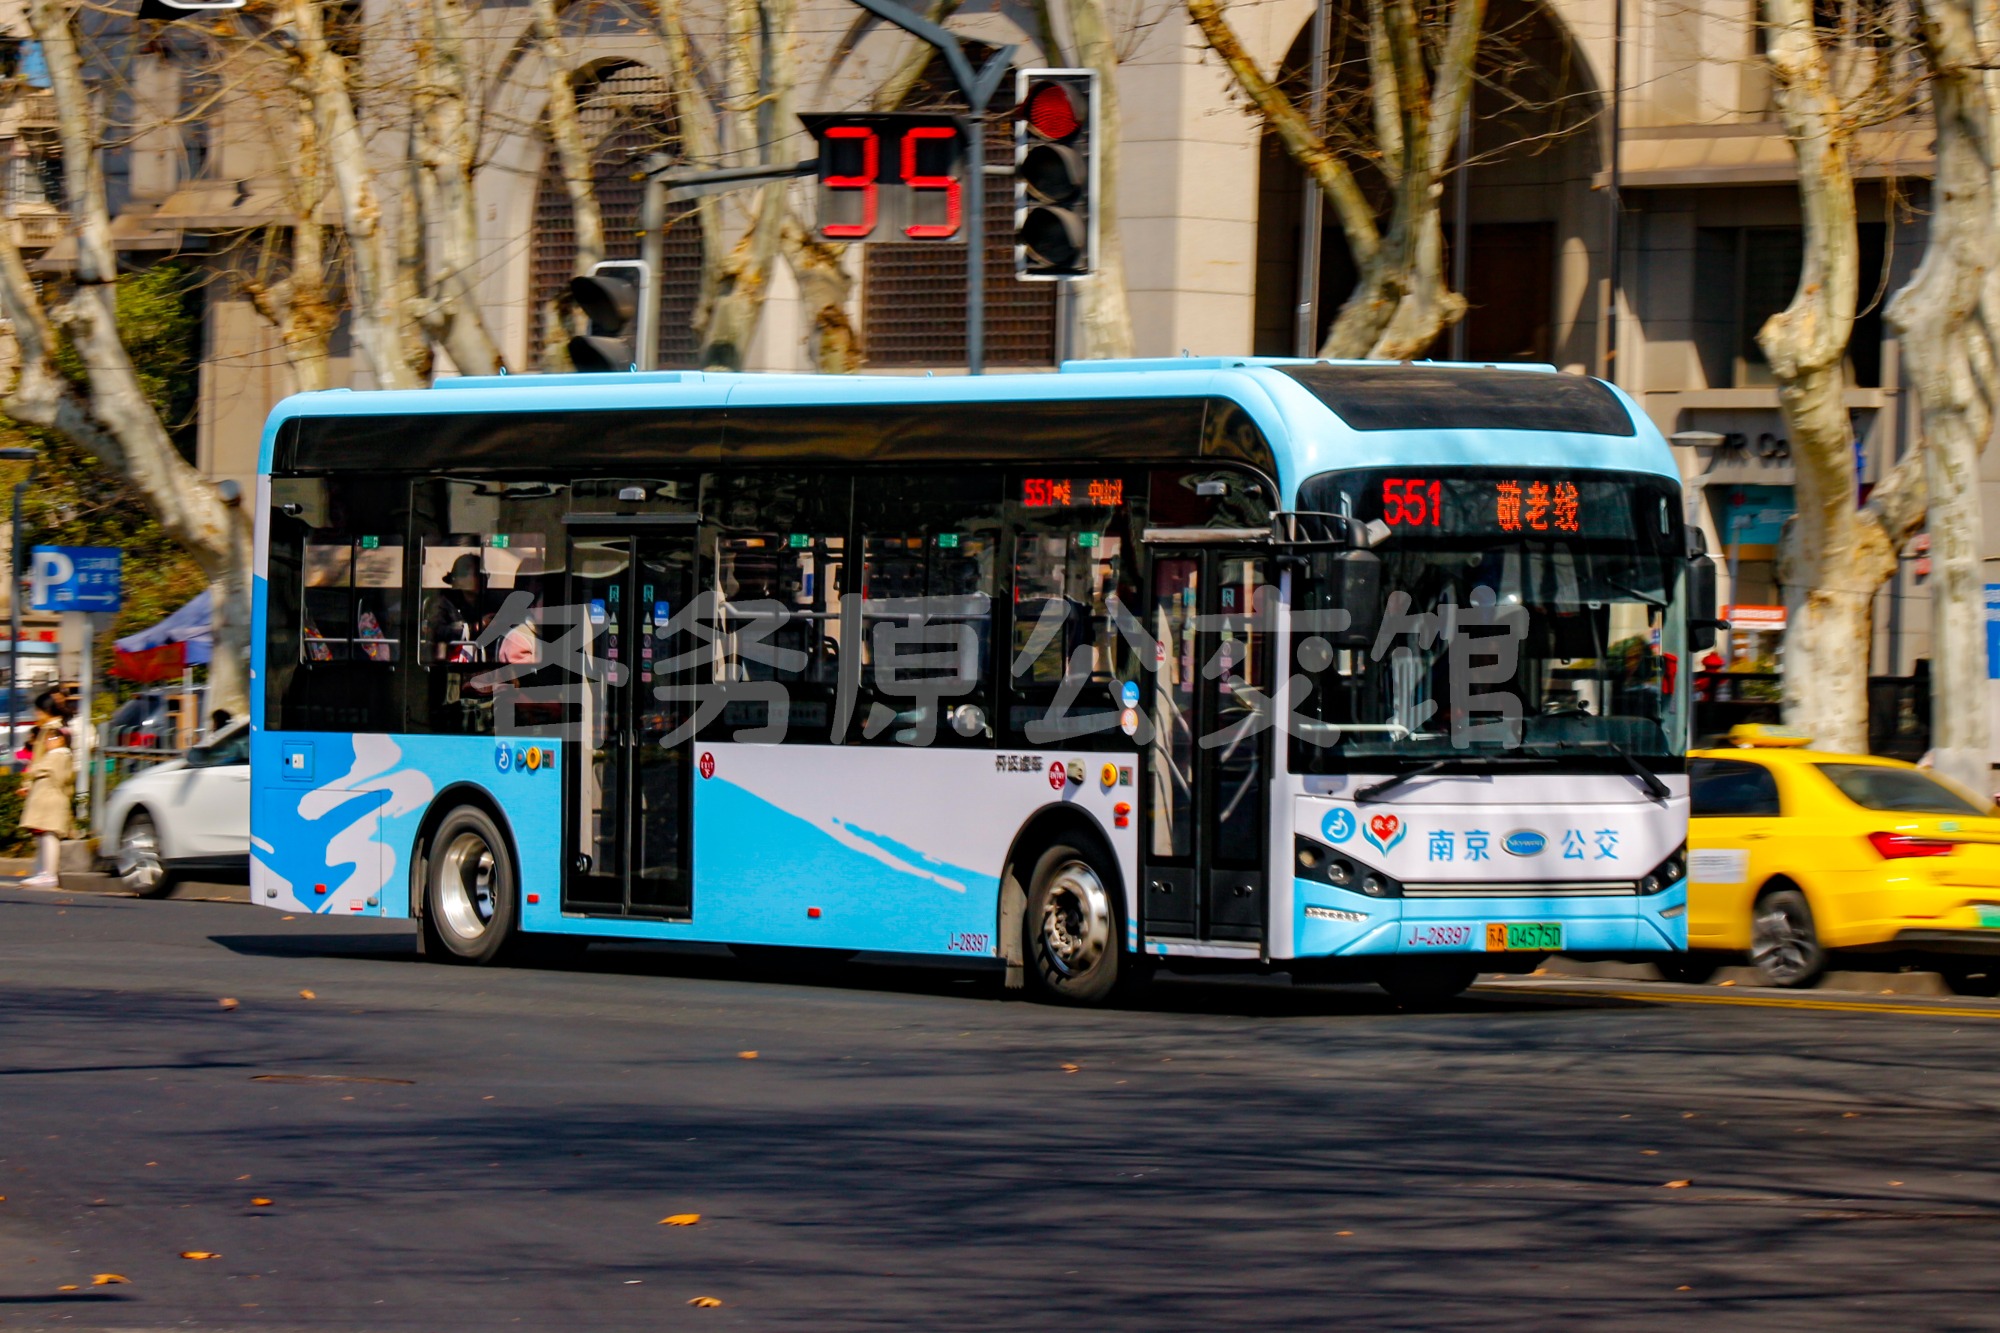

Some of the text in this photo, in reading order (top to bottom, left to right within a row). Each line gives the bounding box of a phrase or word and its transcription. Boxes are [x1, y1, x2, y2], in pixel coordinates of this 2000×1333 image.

[821, 127, 962, 236] 35
[1023, 479, 1053, 506] 551
[1382, 478, 1441, 526] 551
[1496, 480, 1579, 532] 敬老线
[32, 551, 75, 606] P
[1428, 829, 1491, 862] 南京
[1561, 829, 1620, 861] 公交
[947, 931, 989, 953] J-28397
[1408, 927, 1471, 946] J-28397
